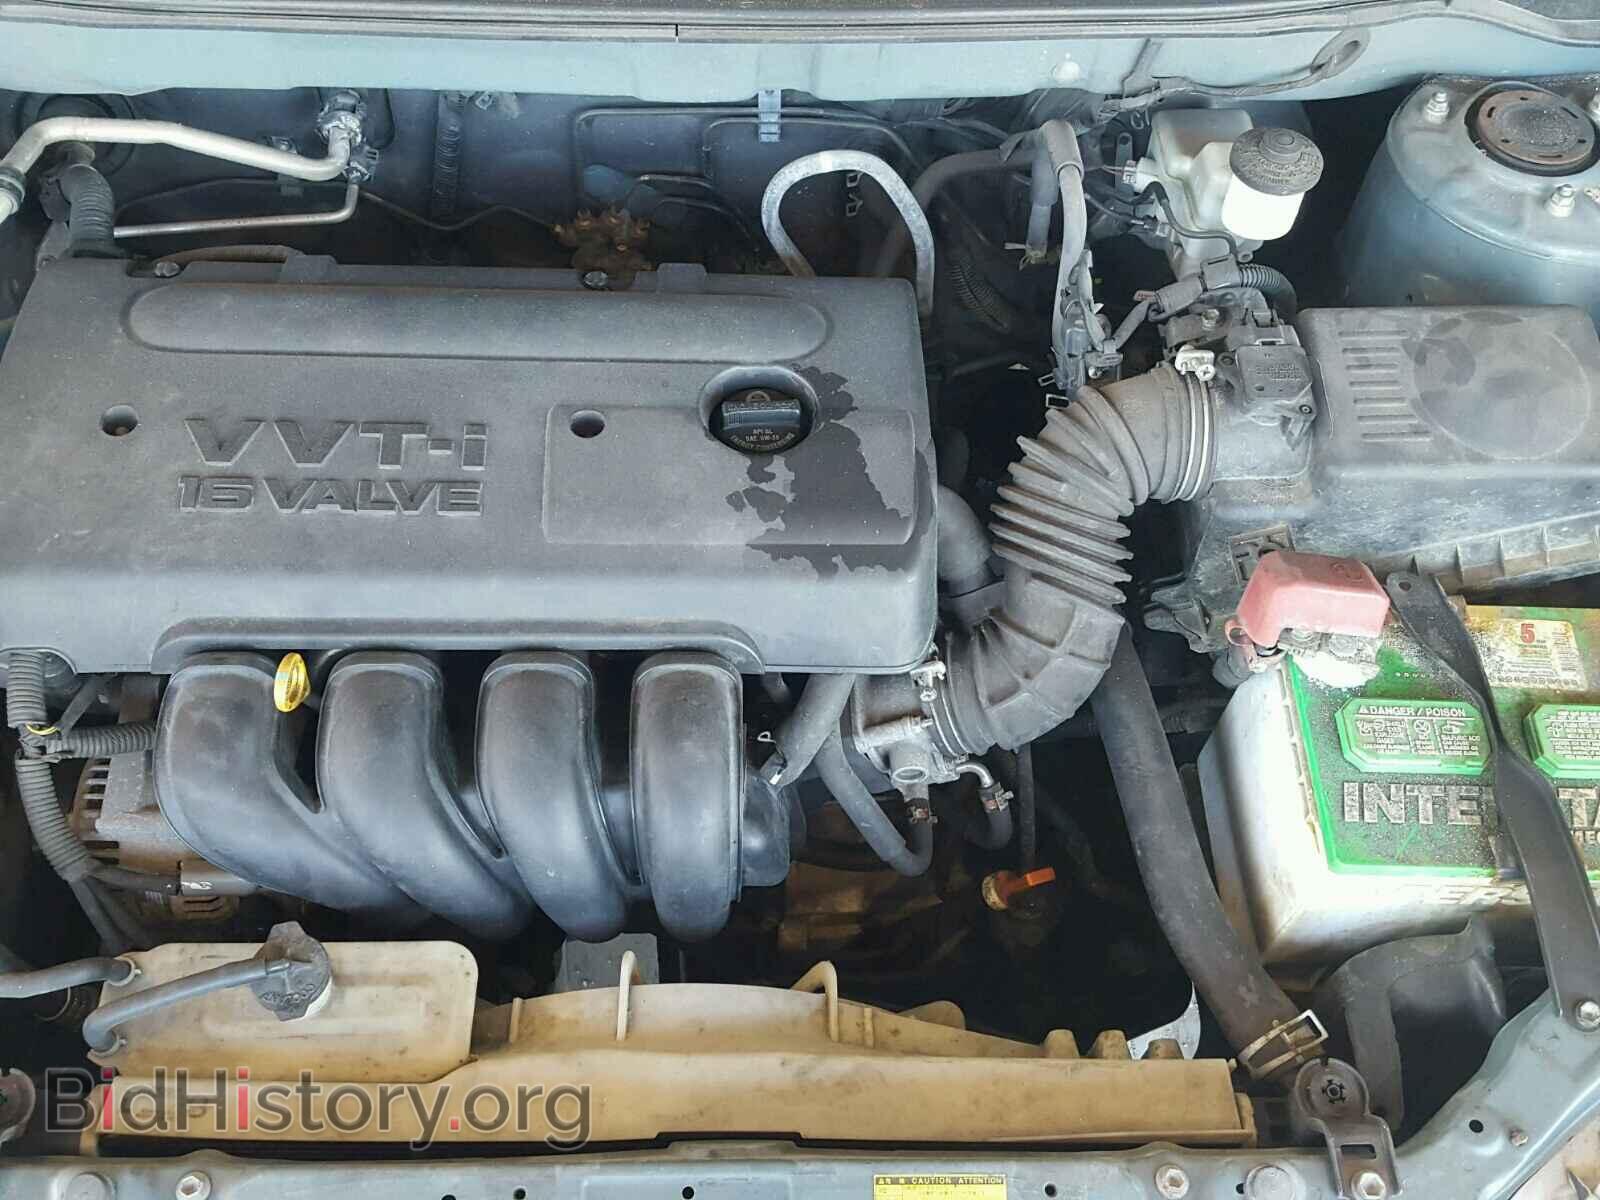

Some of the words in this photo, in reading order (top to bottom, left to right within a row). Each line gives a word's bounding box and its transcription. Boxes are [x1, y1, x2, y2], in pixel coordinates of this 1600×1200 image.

[184, 417, 488, 471] VVT-i
[178, 475, 254, 514] 16
[262, 477, 484, 517] VALVE
[1520, 623, 1536, 644] 5
[1369, 705, 1415, 716] DANGER
[1425, 707, 1466, 717] POISON
[911, 1176, 951, 1185] CAUTION
[958, 1176, 1002, 1185] ATTENTION
